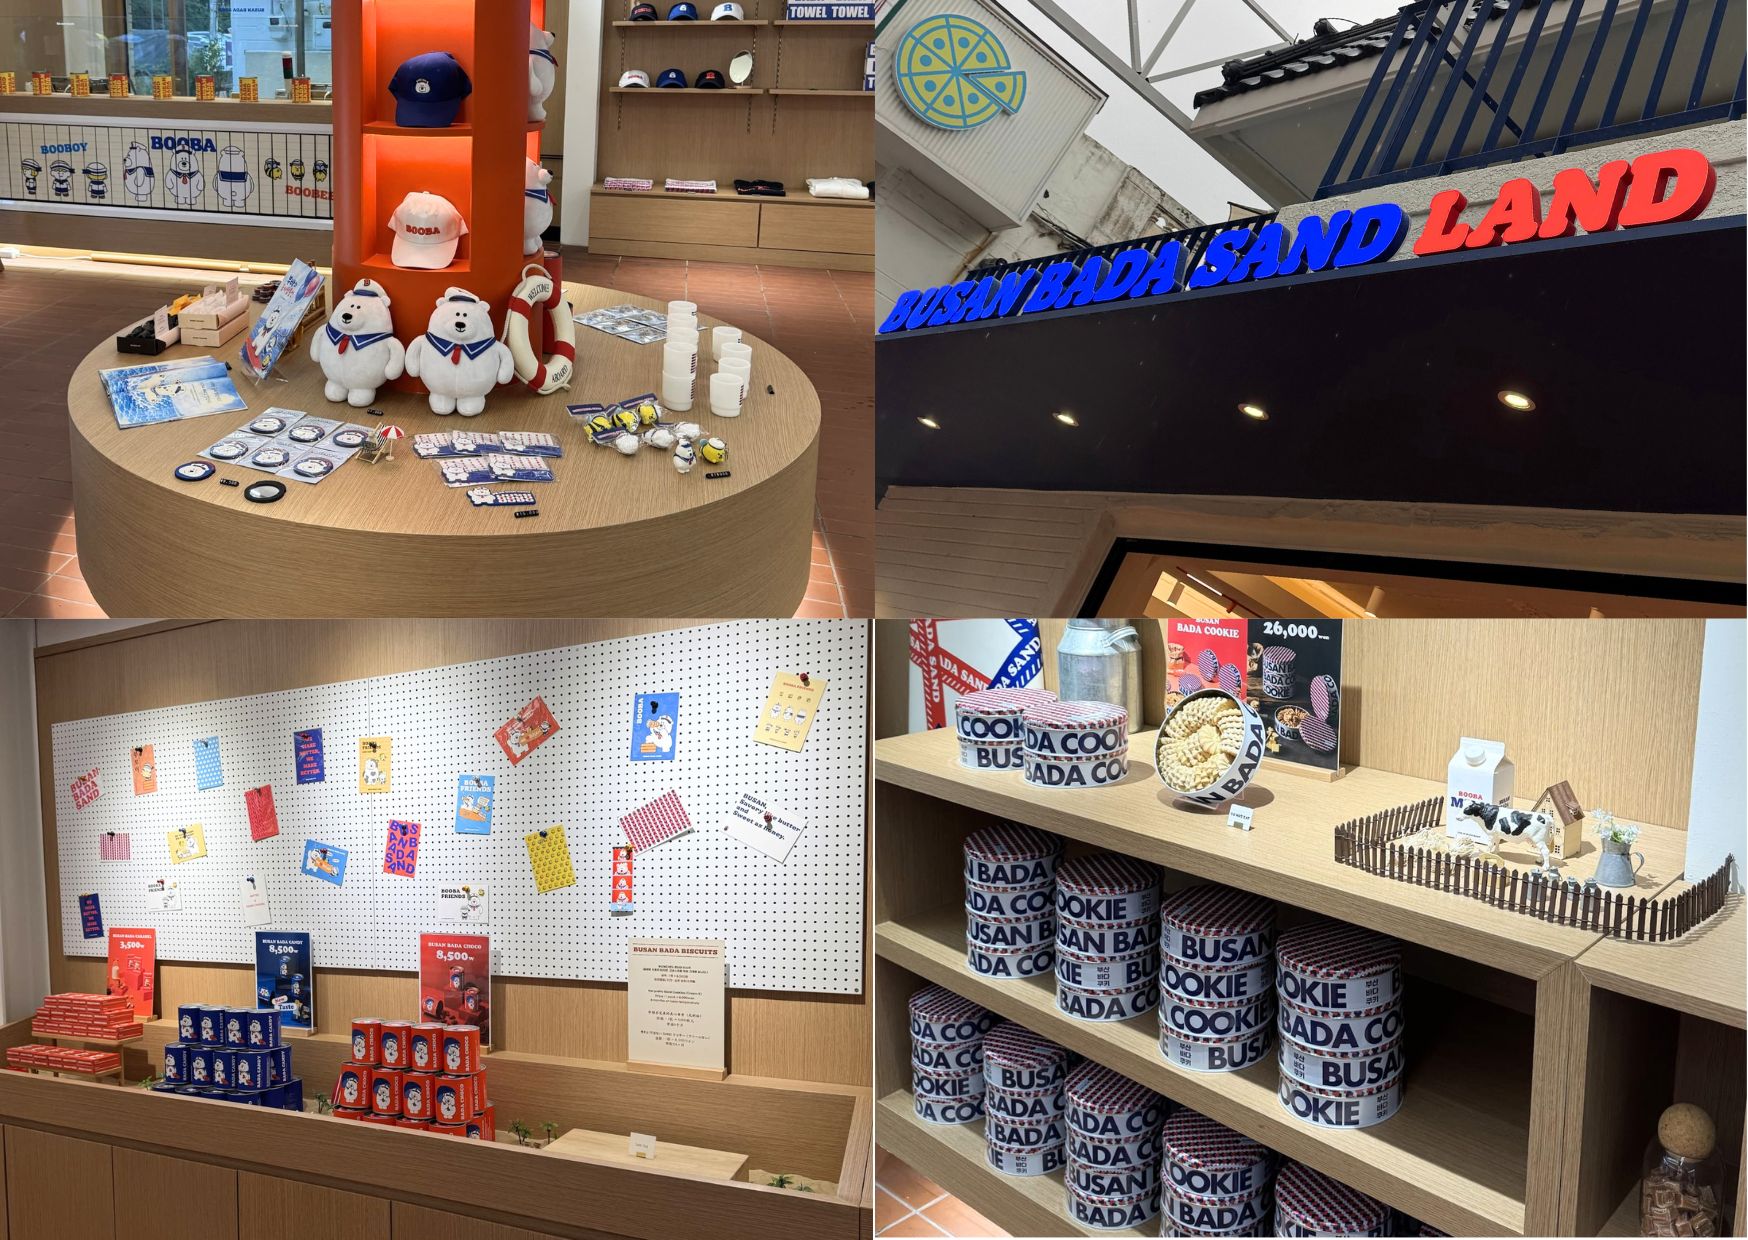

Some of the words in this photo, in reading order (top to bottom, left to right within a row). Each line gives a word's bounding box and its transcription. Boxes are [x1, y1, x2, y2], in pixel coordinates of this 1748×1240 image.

[790, 6, 827, 18] TOWEL
[831, 5, 870, 18] TOWEL
[40, 142, 88, 155] BOOBOY
[150, 135, 217, 153] BOOBA
[405, 224, 441, 236] BOOBA
[878, 268, 1040, 334] BUSAN
[1022, 240, 1190, 314] BADA
[1190, 203, 1410, 290] SAND
[1413, 148, 1717, 256] LAND
[1177, 623, 1202, 634] BADA
[1204, 626, 1240, 638] COOKIE
[1007, 636, 1041, 677] SAND
[930, 656, 940, 703] SAND
[636, 698, 644, 724] BOOBA
[1026, 728, 1057, 754] DA
[1280, 728, 1299, 739] BAD
[1025, 759, 1087, 786] BADA
[1220, 724, 1264, 795] BADA
[73, 780, 98, 801] BADA
[75, 789, 100, 811] SAND
[460, 785, 492, 793] FRIENDS
[743, 793, 767, 809] BUSAN,
[1458, 790, 1483, 800] BOOBA
[733, 810, 754, 824] Sweet
[736, 805, 749, 814] and
[739, 798, 764, 815] Savory
[778, 817, 801, 832] butter
[977, 860, 1049, 885] BADA
[1181, 932, 1273, 963] BUSAN
[1365, 978, 1379, 988] 부산
[1365, 988, 1379, 997] 바다
[1060, 989, 1127, 1019] BADA
[1170, 1002, 1268, 1035] COOKIE
[1281, 1005, 1360, 1049] BADA
[988, 1090, 1049, 1118] BADA
[995, 1122, 1062, 1147] BADA
[1068, 1107, 1121, 1136] ADA
[1068, 1136, 1132, 1166] BADA
[1068, 1163, 1147, 1196] BUSAN
[1076, 1201, 1147, 1228] BADA
[1178, 1202, 1258, 1229] BADA
